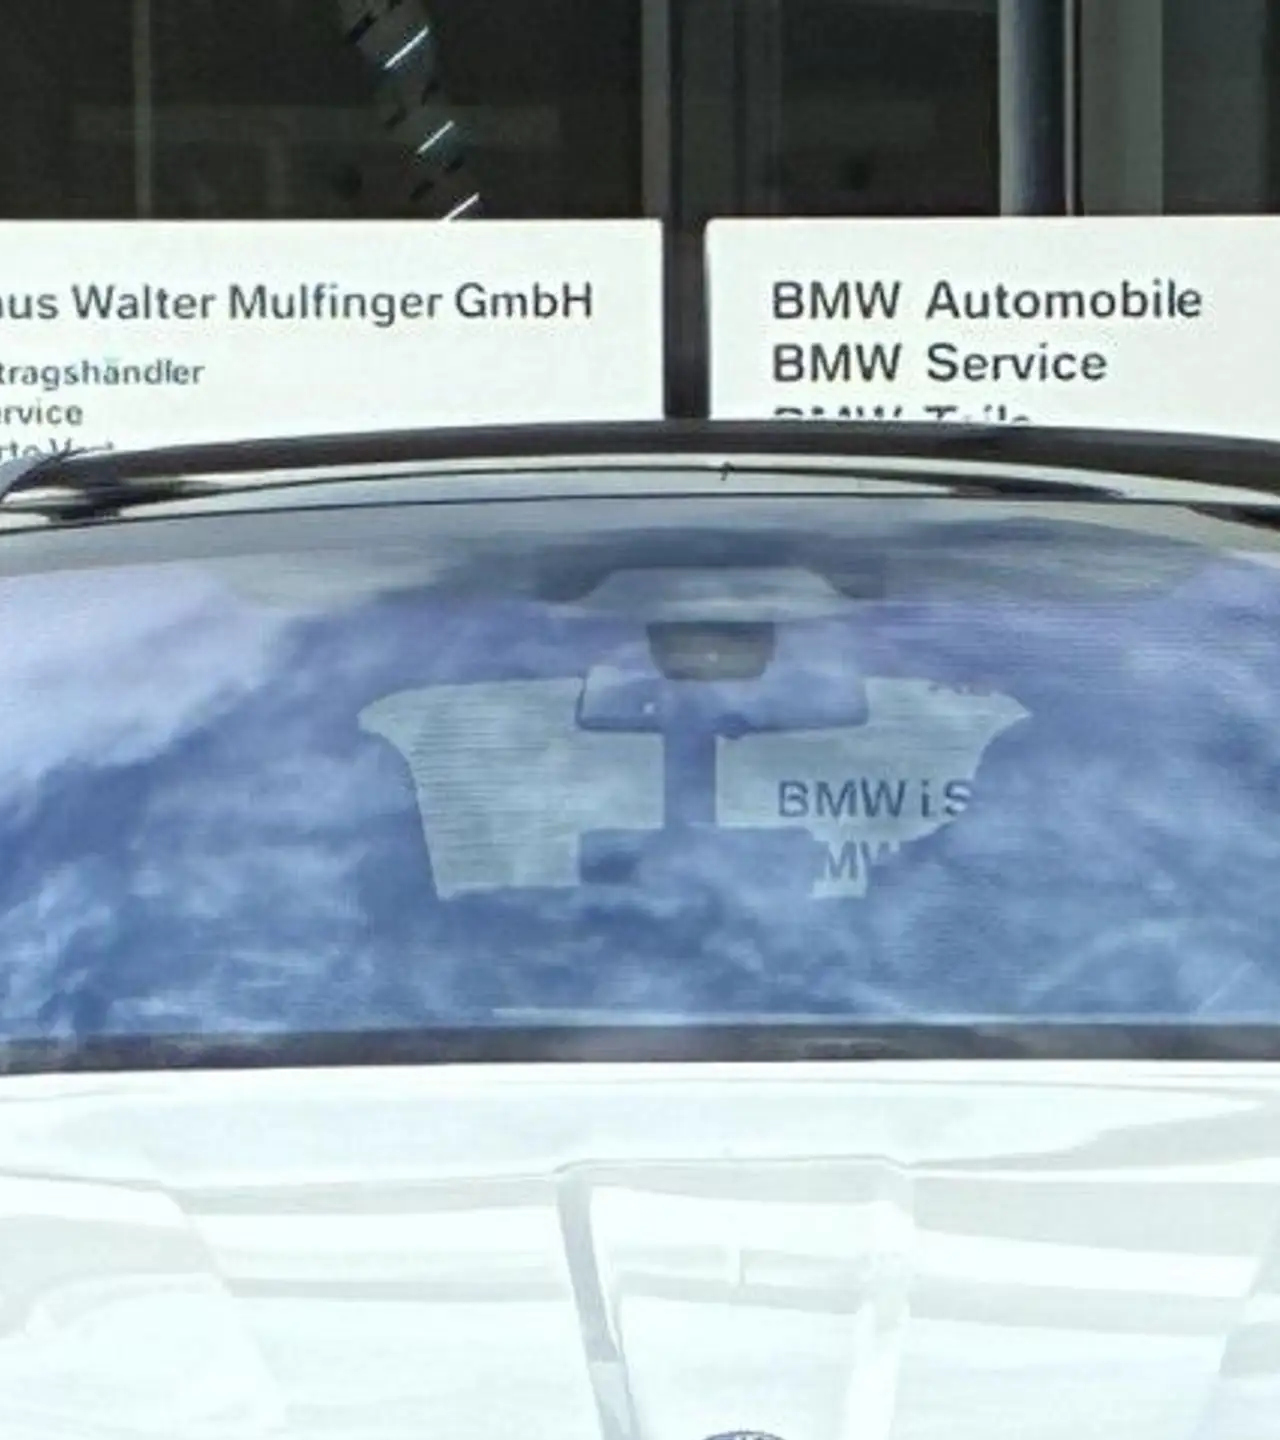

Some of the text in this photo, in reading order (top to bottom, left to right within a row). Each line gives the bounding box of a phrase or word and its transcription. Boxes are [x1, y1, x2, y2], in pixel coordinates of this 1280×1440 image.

[71, 284, 217, 320] Walter
[229, 282, 444, 328] Mulfinger
[455, 282, 592, 319] GmbH
[773, 278, 1202, 319] BMW Automobile
[773, 343, 1108, 382] BMW Service
[778, 778, 906, 817] BMW
[920, 780, 930, 817] i
